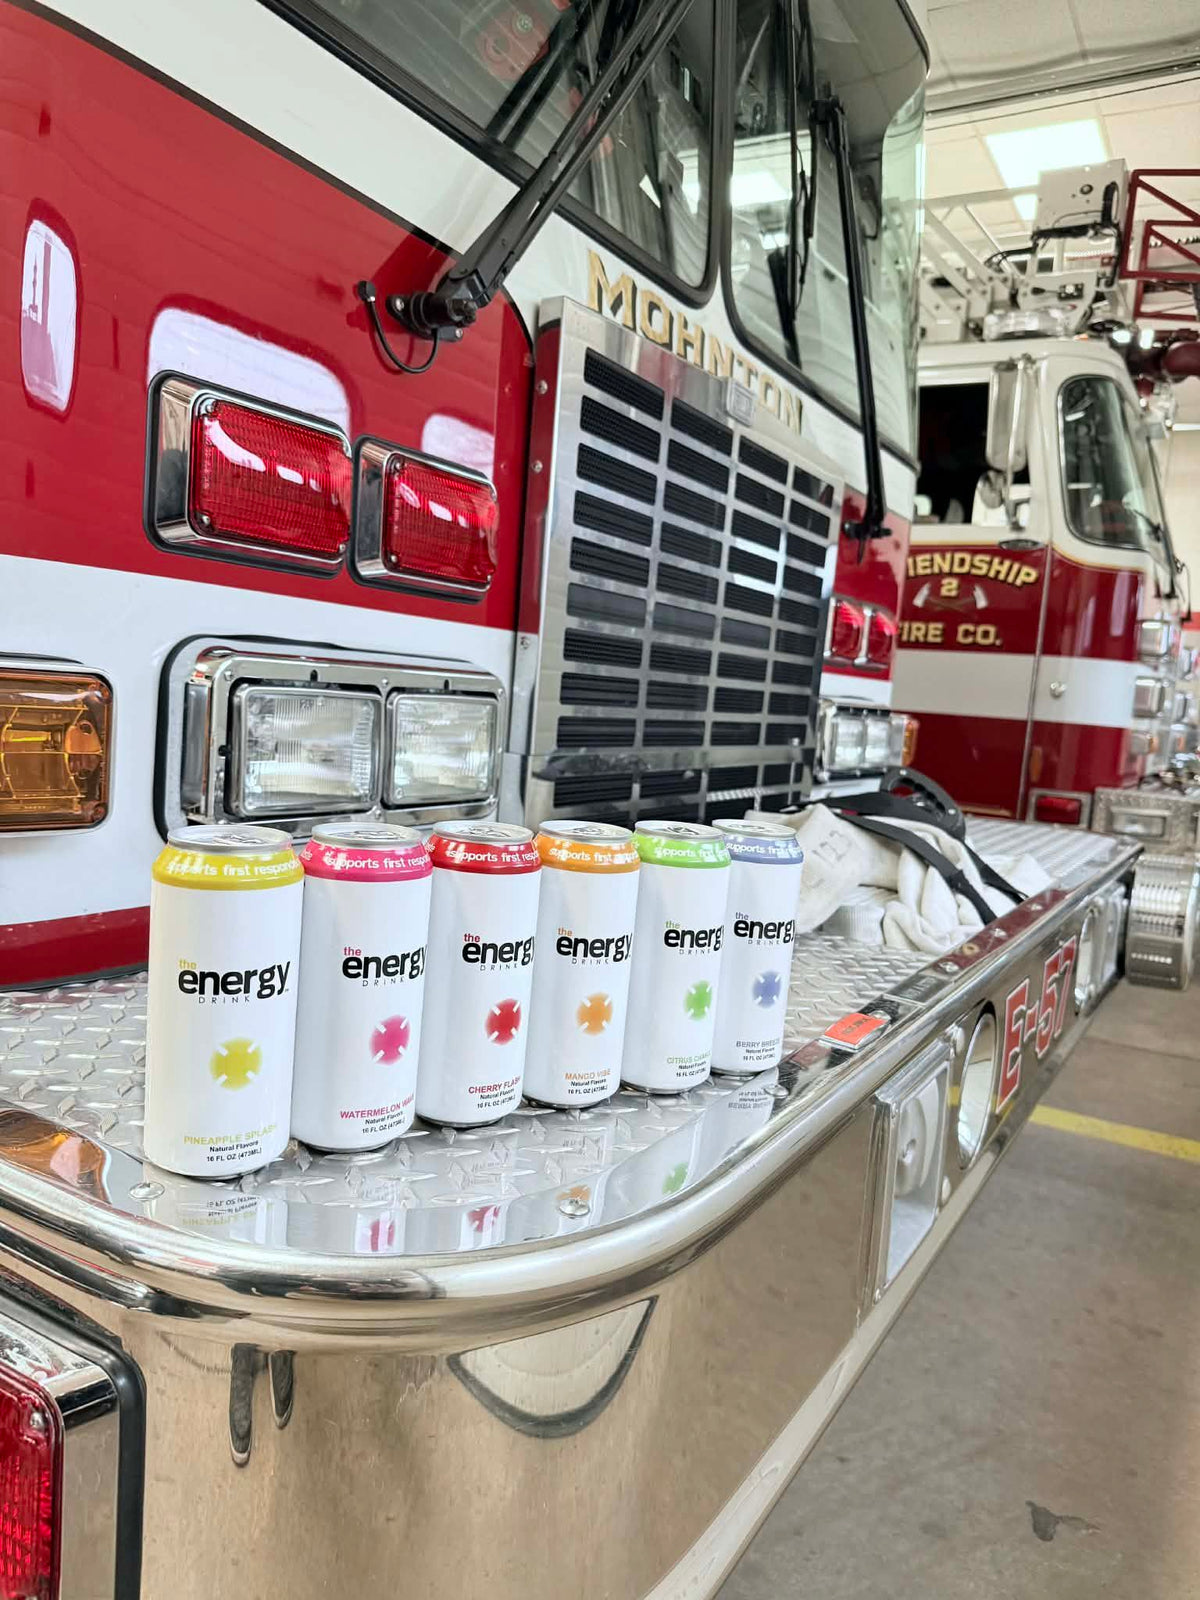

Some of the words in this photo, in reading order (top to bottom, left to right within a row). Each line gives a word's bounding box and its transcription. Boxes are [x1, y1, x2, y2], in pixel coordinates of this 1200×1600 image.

[588, 250, 802, 435] MOHNTON
[907, 552, 1039, 587] IENDSHIP
[940, 577, 959, 597] 2
[957, 623, 1002, 646] CO.
[446, 850, 498, 863] supports
[501, 852, 520, 861] first
[384, 857, 406, 868] first
[223, 864, 249, 876] first
[735, 912, 749, 920] the
[665, 920, 680, 929] the
[558, 927, 573, 936] the
[464, 933, 480, 942] the
[343, 946, 361, 956] the
[556, 933, 632, 962] energy
[179, 959, 197, 969] the
[342, 944, 427, 979] energy
[178, 960, 290, 999] energy
[362, 976, 404, 987] DRINK
[198, 995, 250, 1004] DRINK
[997, 935, 1077, 1114] E-57
[736, 1040, 760, 1048] BERRY
[667, 1056, 692, 1064] CITRUS
[565, 1072, 595, 1080] MANGO
[468, 1083, 502, 1094] CHERRY
[340, 1102, 401, 1119] WATERMELON
[365, 1116, 386, 1125] Natural
[183, 1133, 241, 1145] PINEAPPLE
[209, 1144, 234, 1153] Natural
[236, 1140, 258, 1150] Flavors
